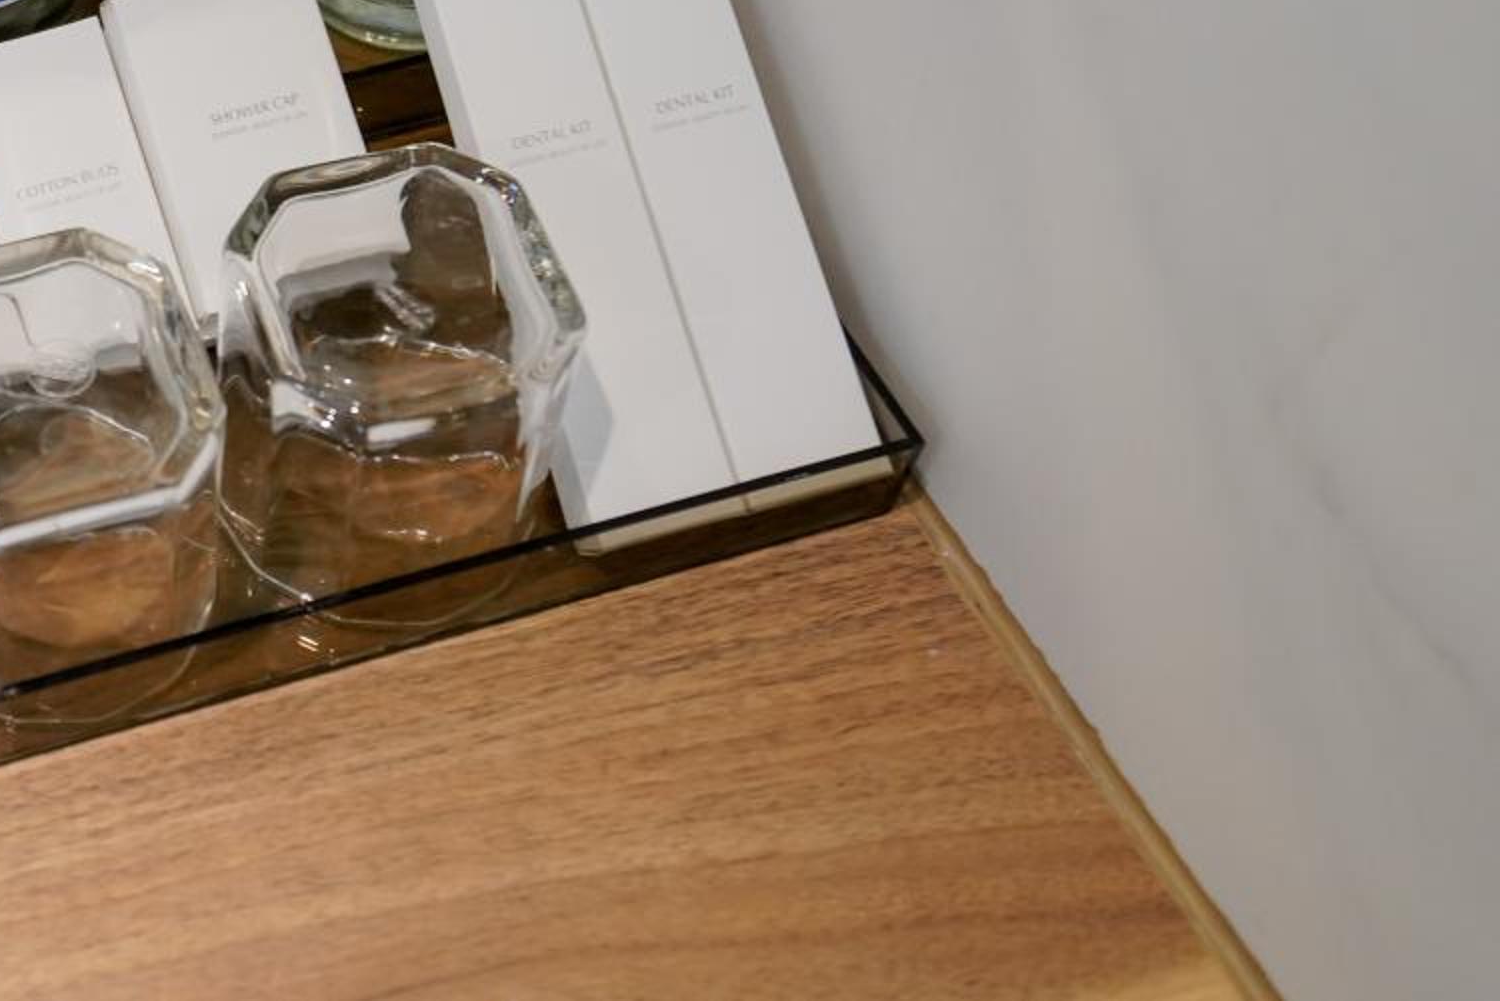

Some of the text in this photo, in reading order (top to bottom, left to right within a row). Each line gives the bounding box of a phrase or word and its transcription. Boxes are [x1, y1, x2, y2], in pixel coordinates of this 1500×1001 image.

[208, 91, 301, 123] SHOWER CAP
[654, 84, 734, 115] DENTAL KIT
[511, 118, 592, 150] DENTAL KIT
[14, 175, 79, 200] COTTON
